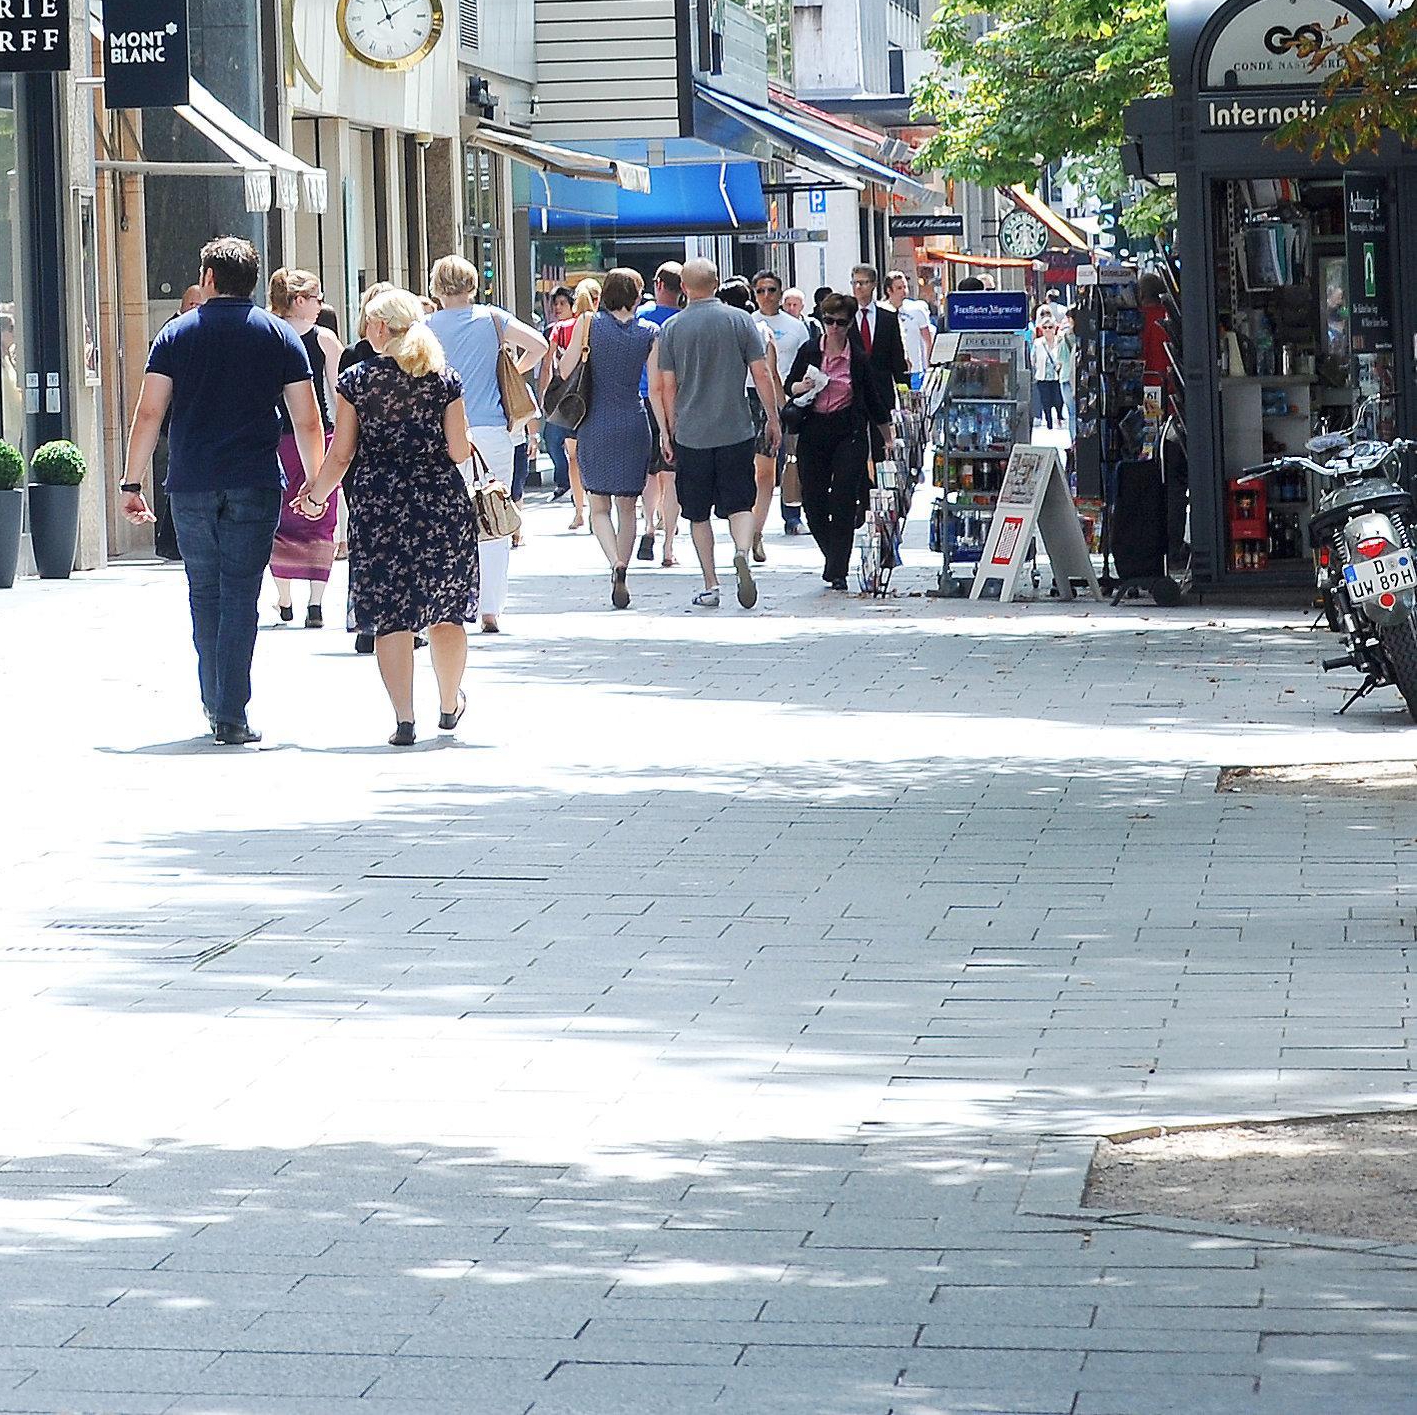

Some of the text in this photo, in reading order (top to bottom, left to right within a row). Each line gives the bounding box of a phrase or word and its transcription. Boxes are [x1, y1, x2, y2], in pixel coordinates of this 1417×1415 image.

[110, 30, 165, 48] MONT
[110, 46, 166, 64] BLANC
[1233, 58, 1273, 72] CONDÉ
[1373, 559, 1386, 575] D
[1352, 568, 1414, 599] UW 89H
